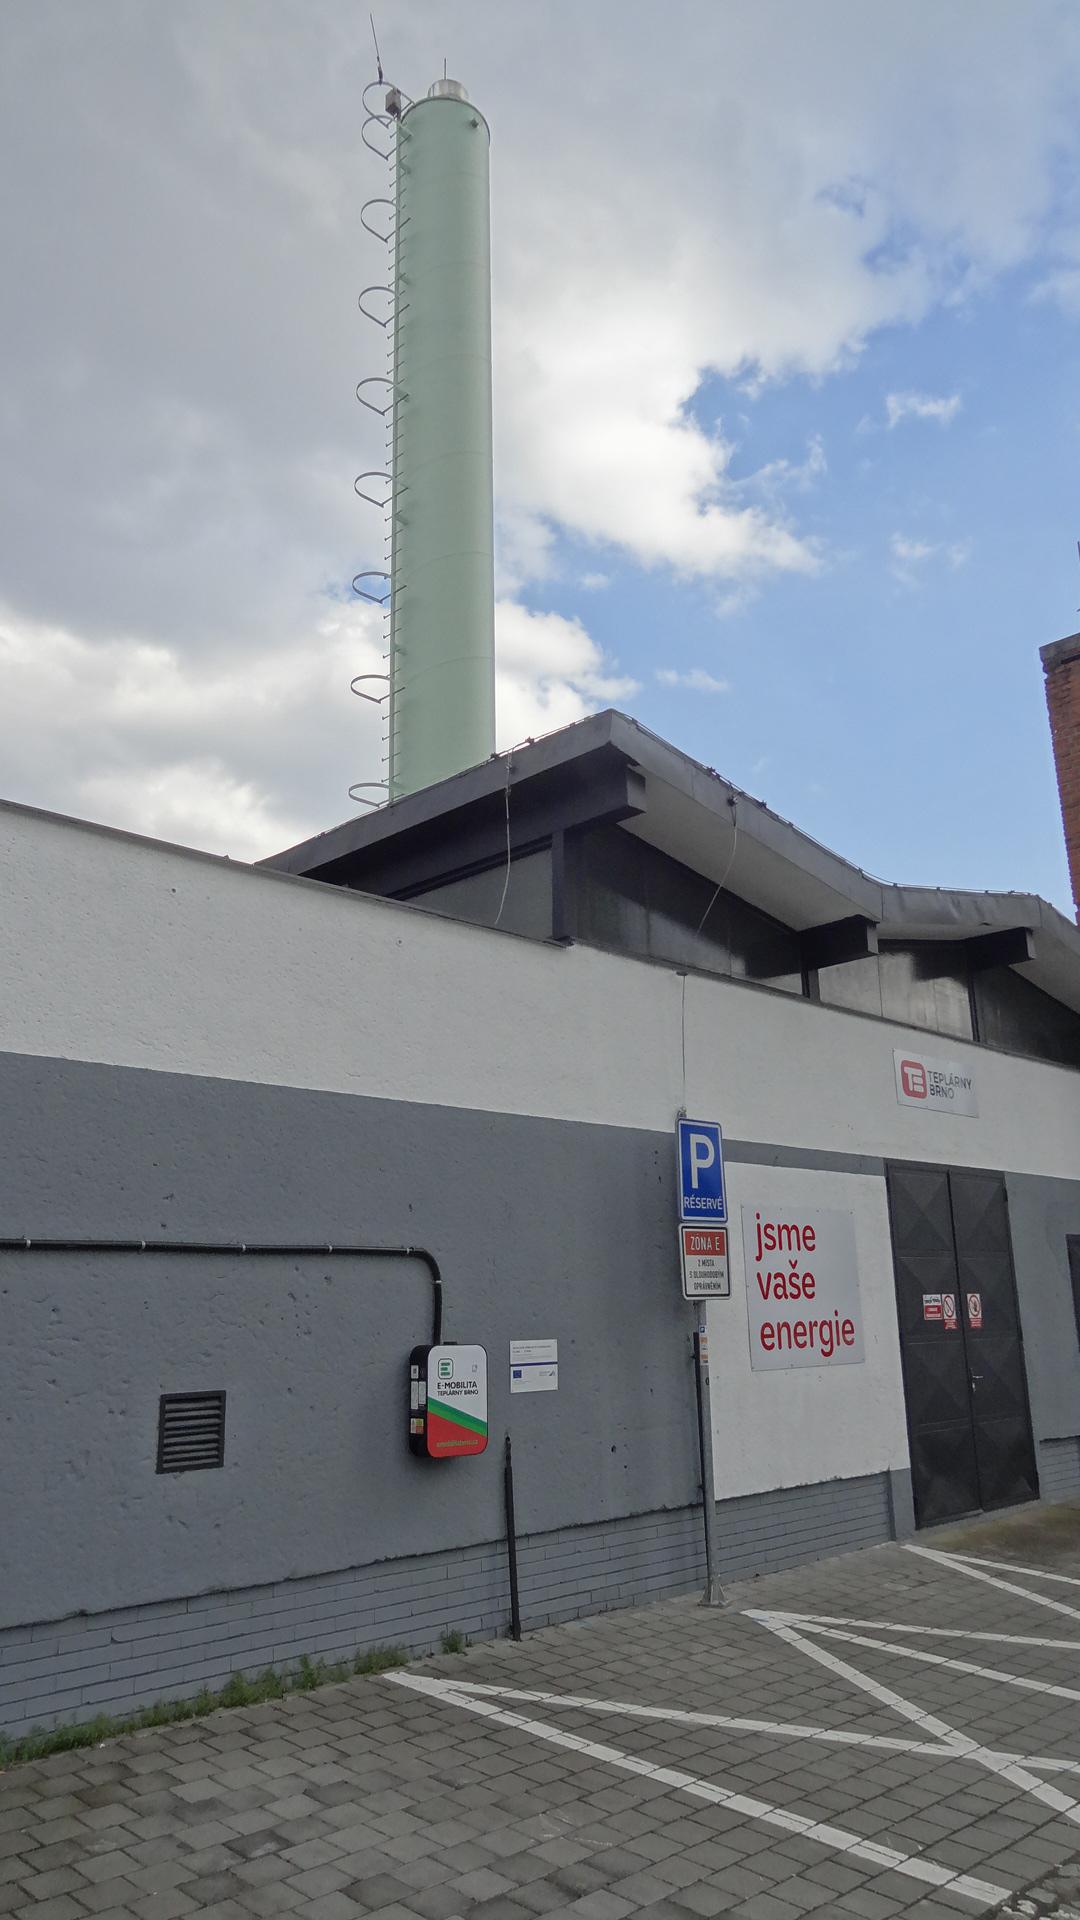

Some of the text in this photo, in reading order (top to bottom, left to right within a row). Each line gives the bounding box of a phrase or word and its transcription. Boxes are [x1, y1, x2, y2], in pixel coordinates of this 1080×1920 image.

[927, 1070, 972, 1090] TEPLÁRNY
[929, 1084, 955, 1100] BRNO
[690, 1133, 715, 1189] P
[683, 1195, 723, 1210] RÉSERVÉ
[690, 1234, 721, 1251] ZÓNA E
[755, 1212, 816, 1262] jsme
[756, 1259, 816, 1300] vaše
[760, 1309, 855, 1357] energie
[437, 1381, 478, 1390] E-MOBILITA
